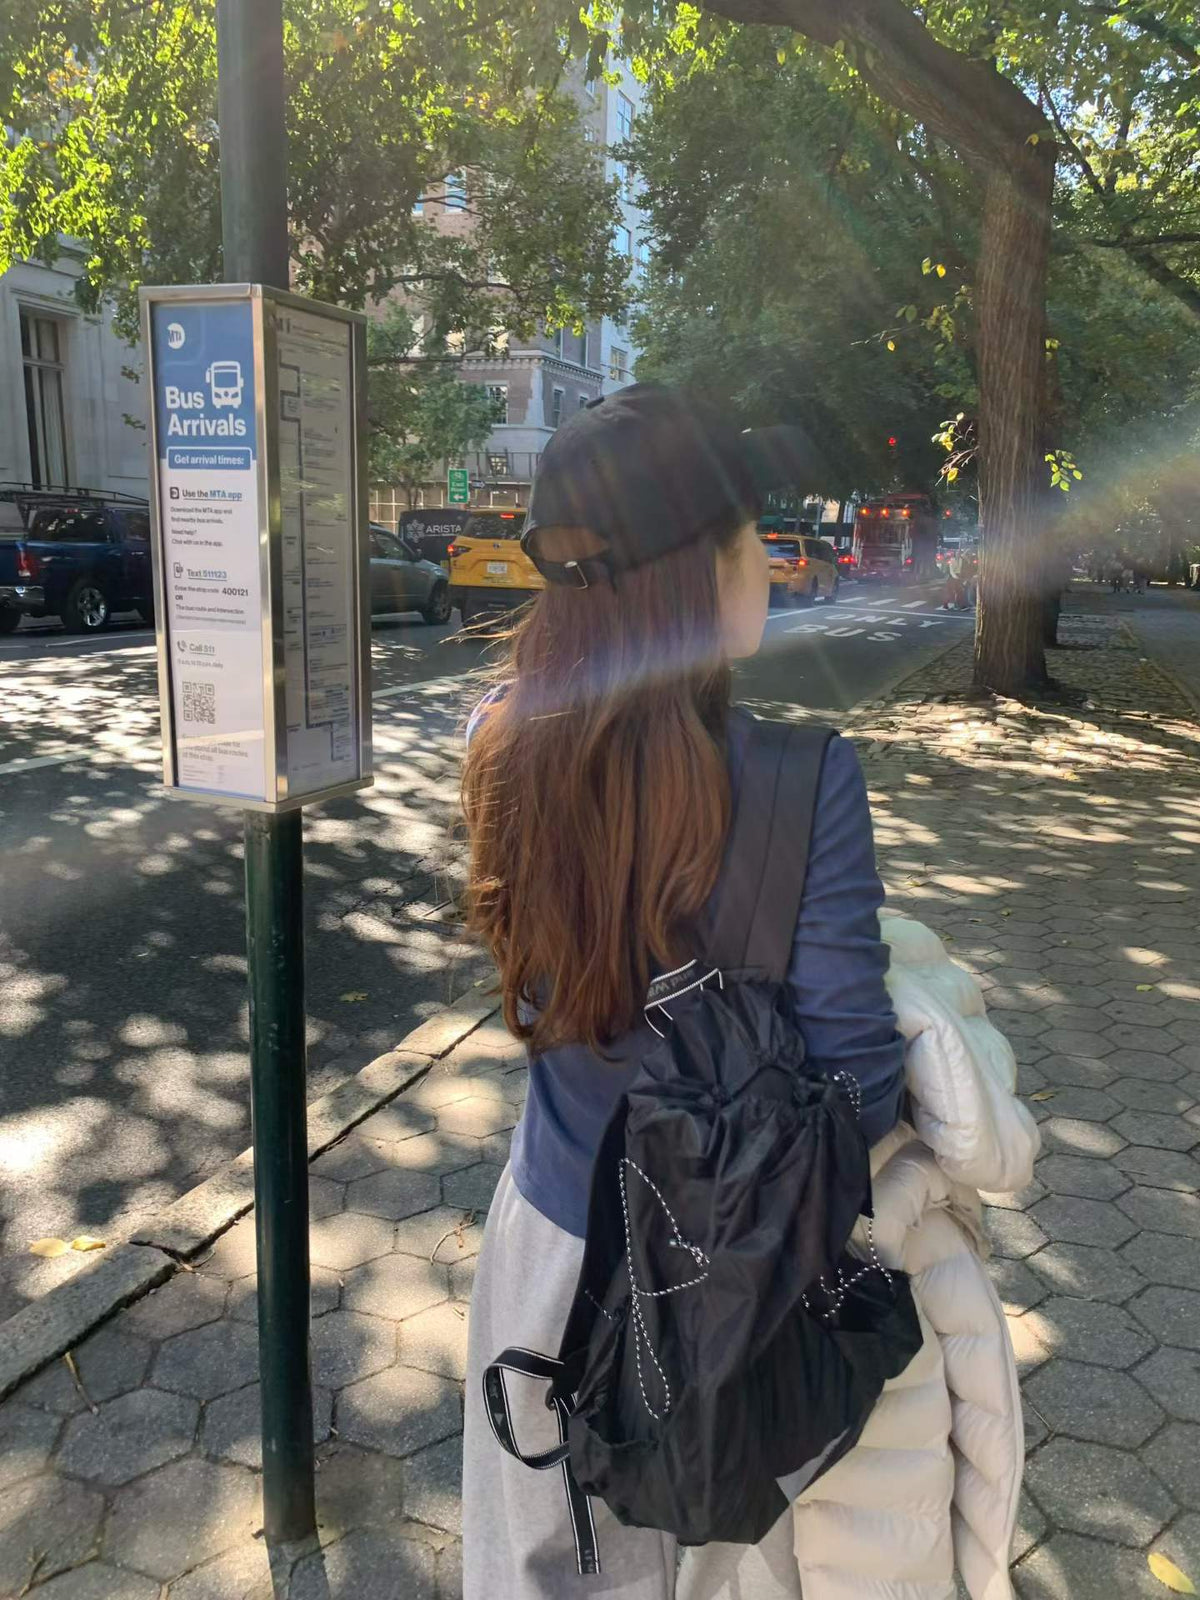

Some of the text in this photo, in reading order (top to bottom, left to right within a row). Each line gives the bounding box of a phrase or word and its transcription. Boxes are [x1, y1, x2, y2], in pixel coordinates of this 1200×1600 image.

[165, 386, 205, 409] Bus
[167, 413, 247, 437] Arrivals
[174, 454, 244, 465] Get arrival times:
[182, 489, 242, 501] Use the MTA app
[426, 524, 462, 534] ARISTA
[187, 568, 227, 579] Text 511123
[222, 587, 249, 596] 400121
[825, 613, 945, 628] ONLY
[783, 624, 903, 642] BUS
[189, 643, 215, 653] Call 511
